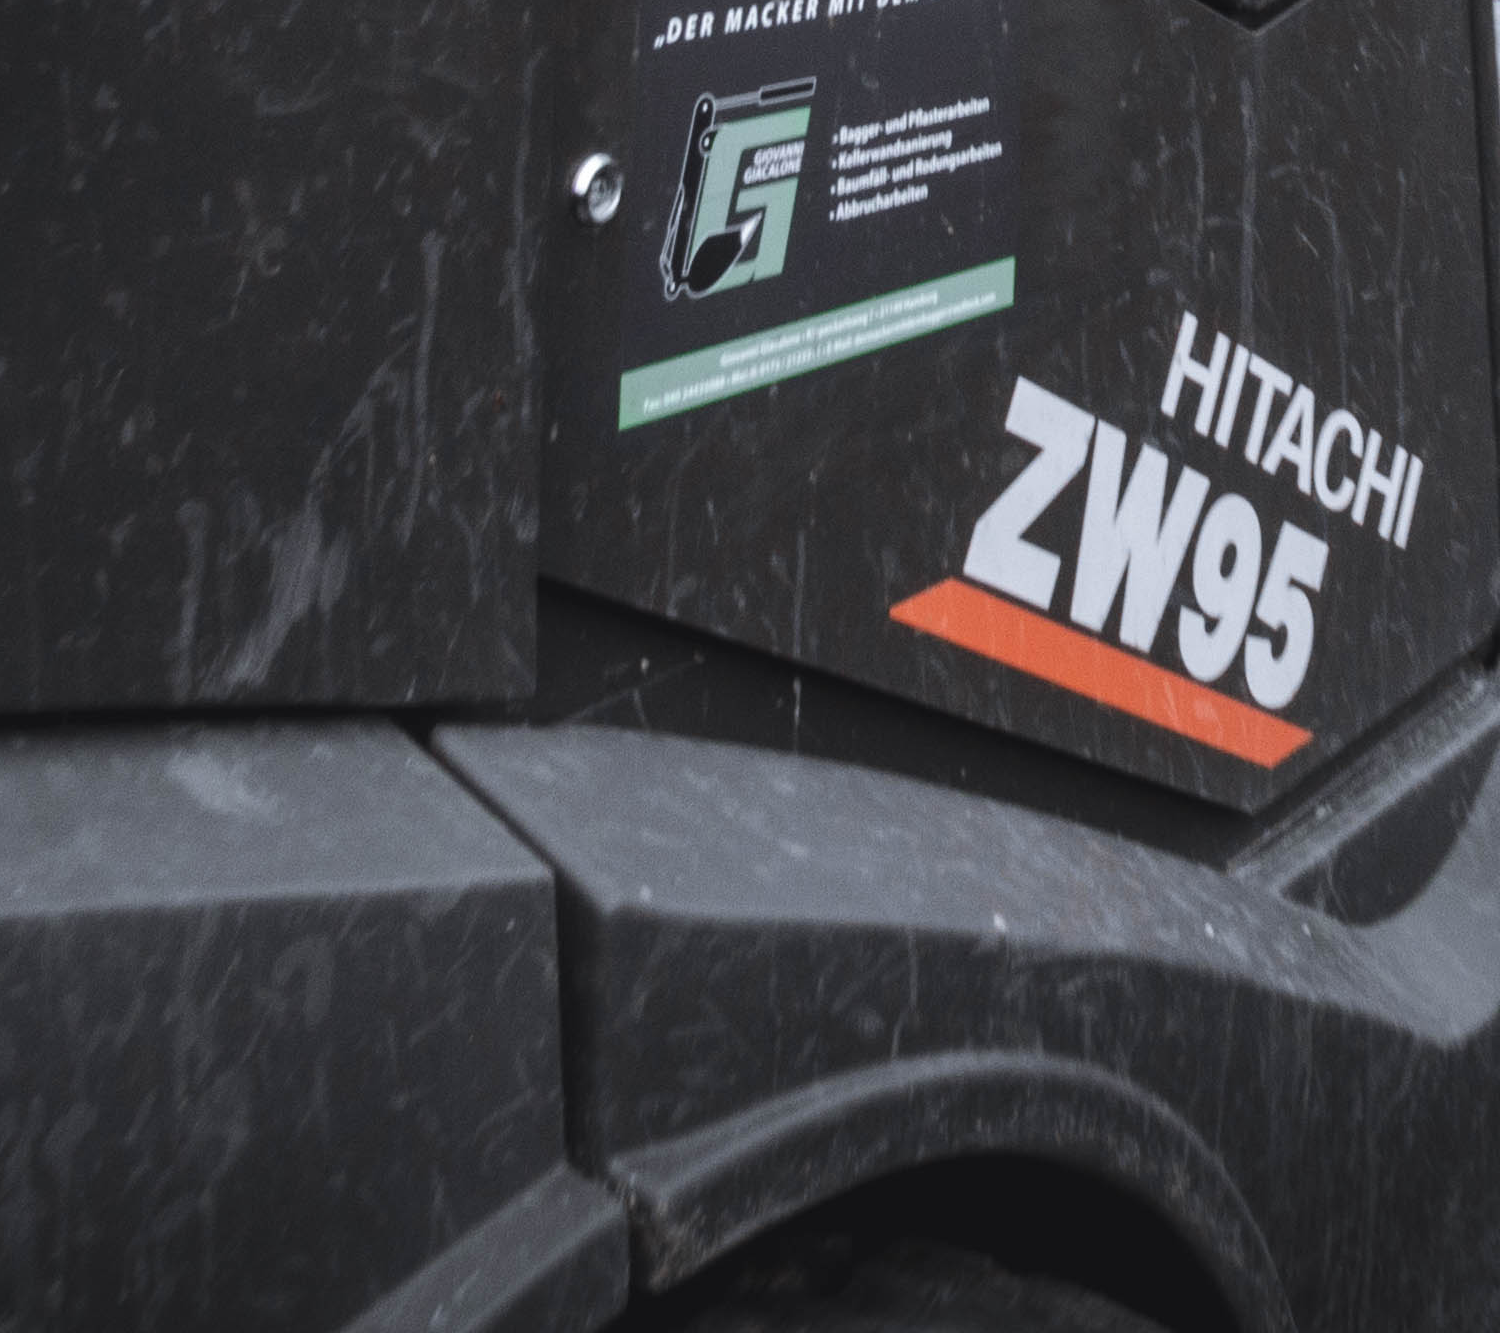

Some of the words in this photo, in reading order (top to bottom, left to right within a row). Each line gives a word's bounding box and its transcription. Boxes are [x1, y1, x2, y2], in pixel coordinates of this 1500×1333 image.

[885, 112, 908, 135] und
[891, 159, 914, 182] und
[1160, 310, 1424, 550] HITACHI
[963, 375, 1330, 711] ZW95
